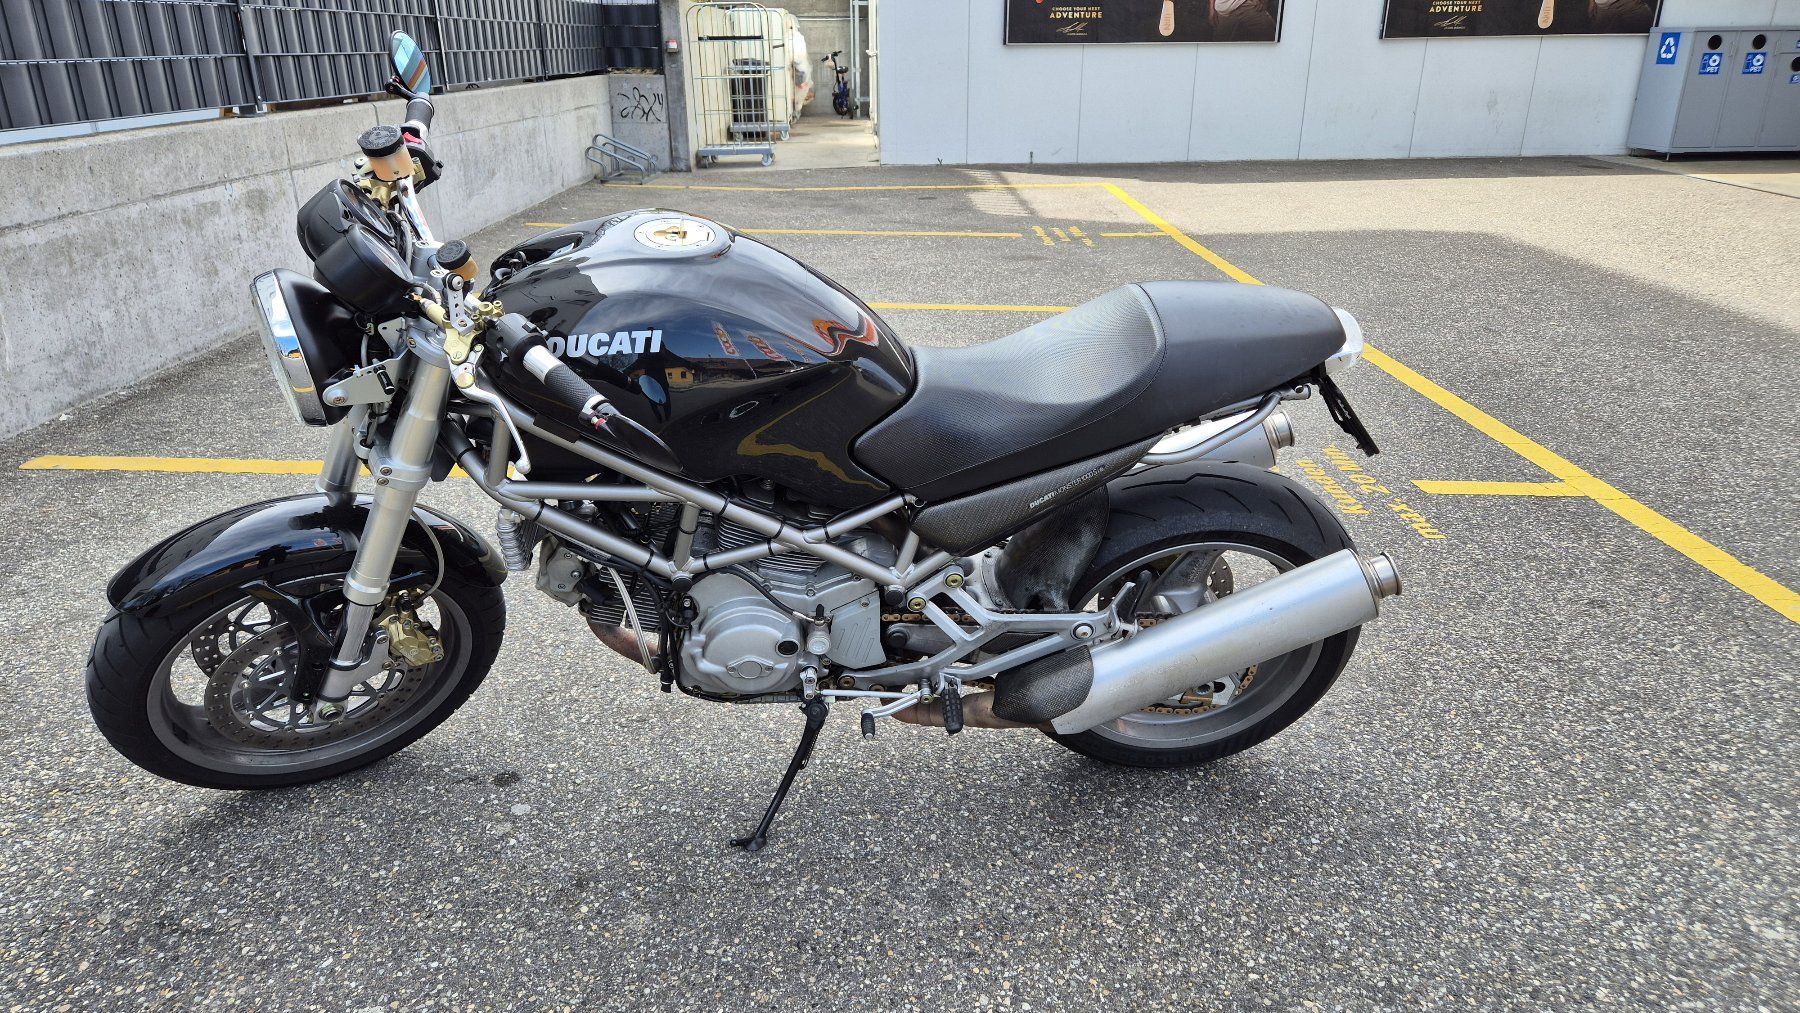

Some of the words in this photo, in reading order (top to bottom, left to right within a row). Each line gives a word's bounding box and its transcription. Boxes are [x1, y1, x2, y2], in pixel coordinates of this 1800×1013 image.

[1050, 11, 1103, 19] ADVENTURE
[1429, 5, 1483, 13] ADVENTURE
[546, 329, 663, 360] DUCATI
[1349, 474, 1391, 494] 20
[1029, 491, 1055, 509] DUCATI
